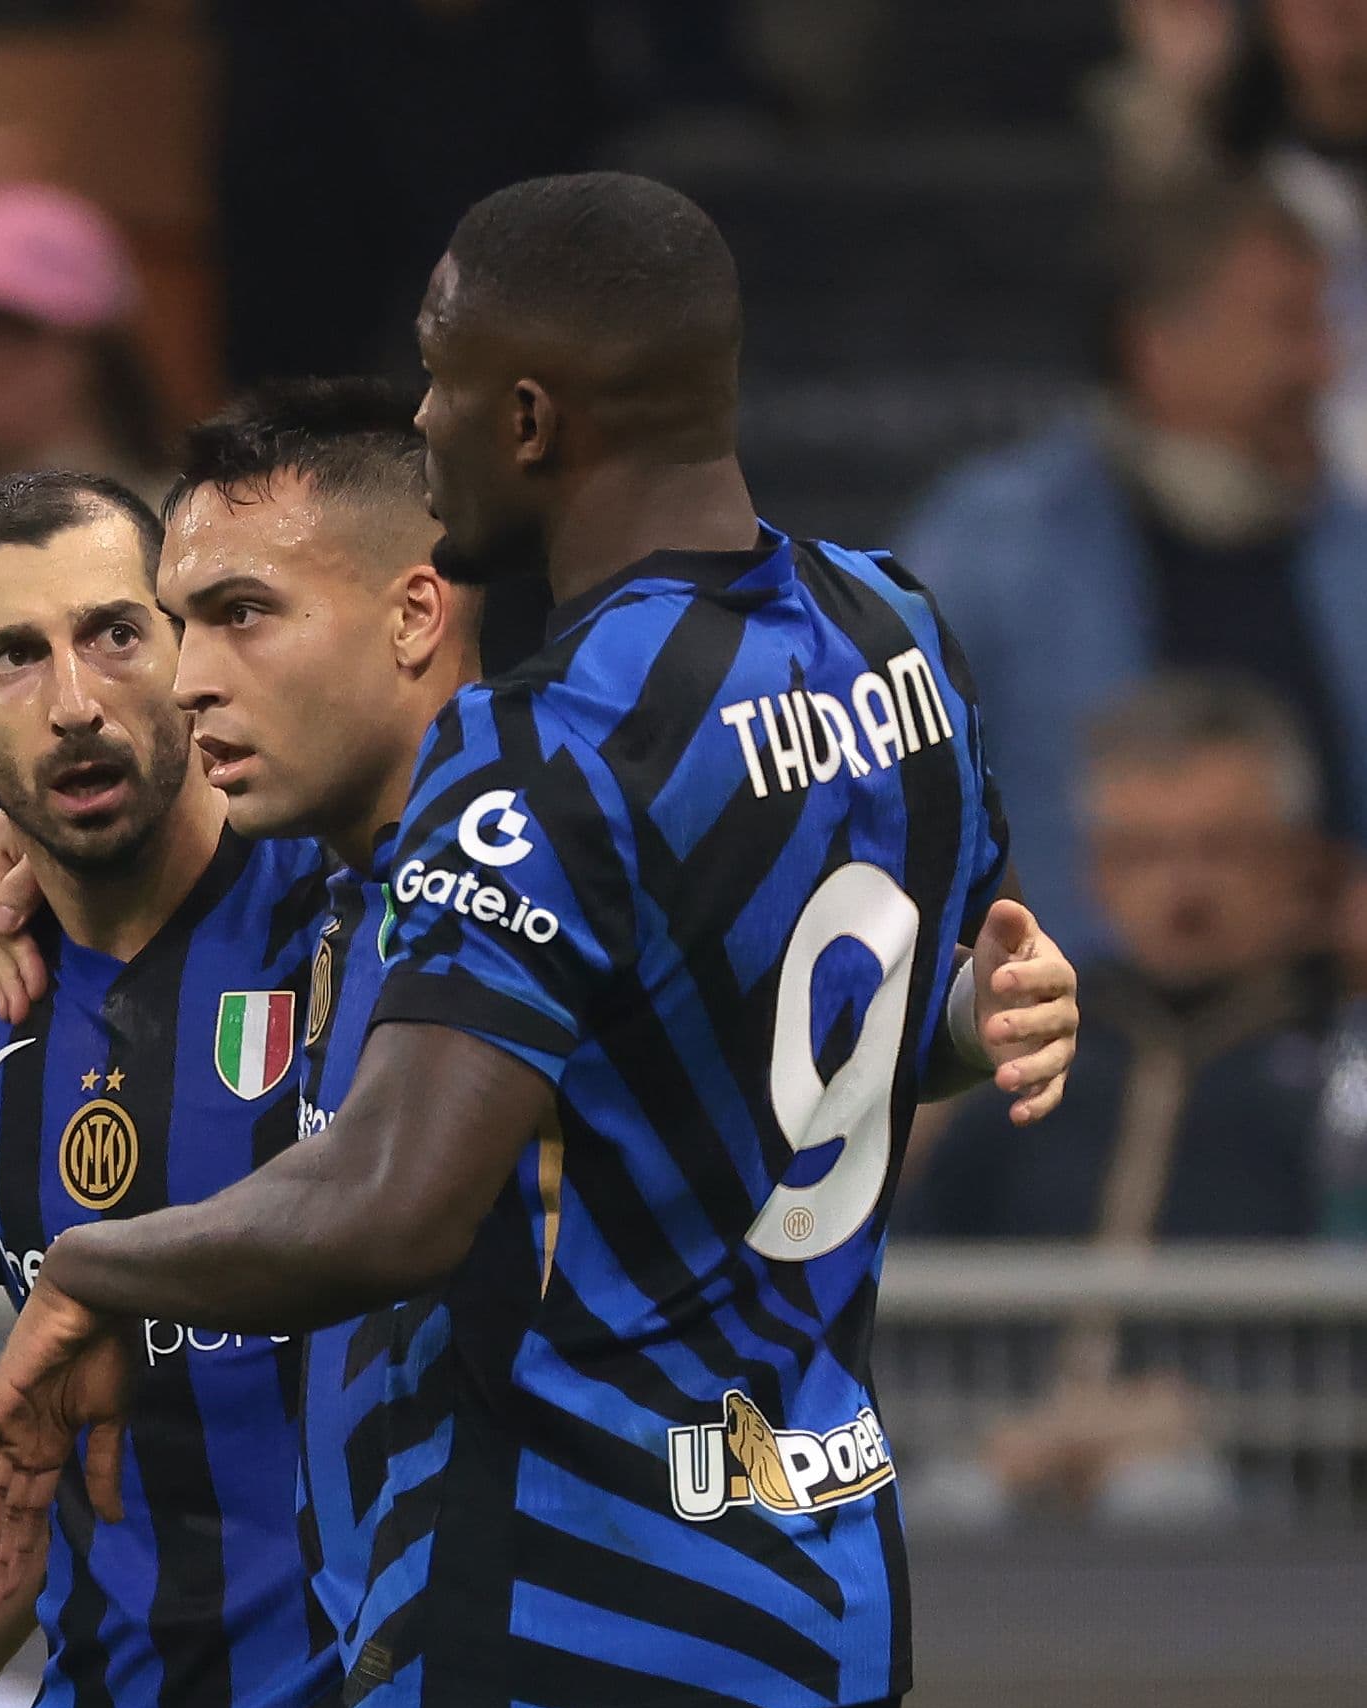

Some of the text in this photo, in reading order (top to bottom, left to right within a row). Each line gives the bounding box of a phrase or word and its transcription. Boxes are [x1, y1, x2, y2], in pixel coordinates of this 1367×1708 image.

[719, 646, 954, 799] THURAM
[395, 859, 559, 944] Gate.io
[745, 860, 920, 1262] 9
